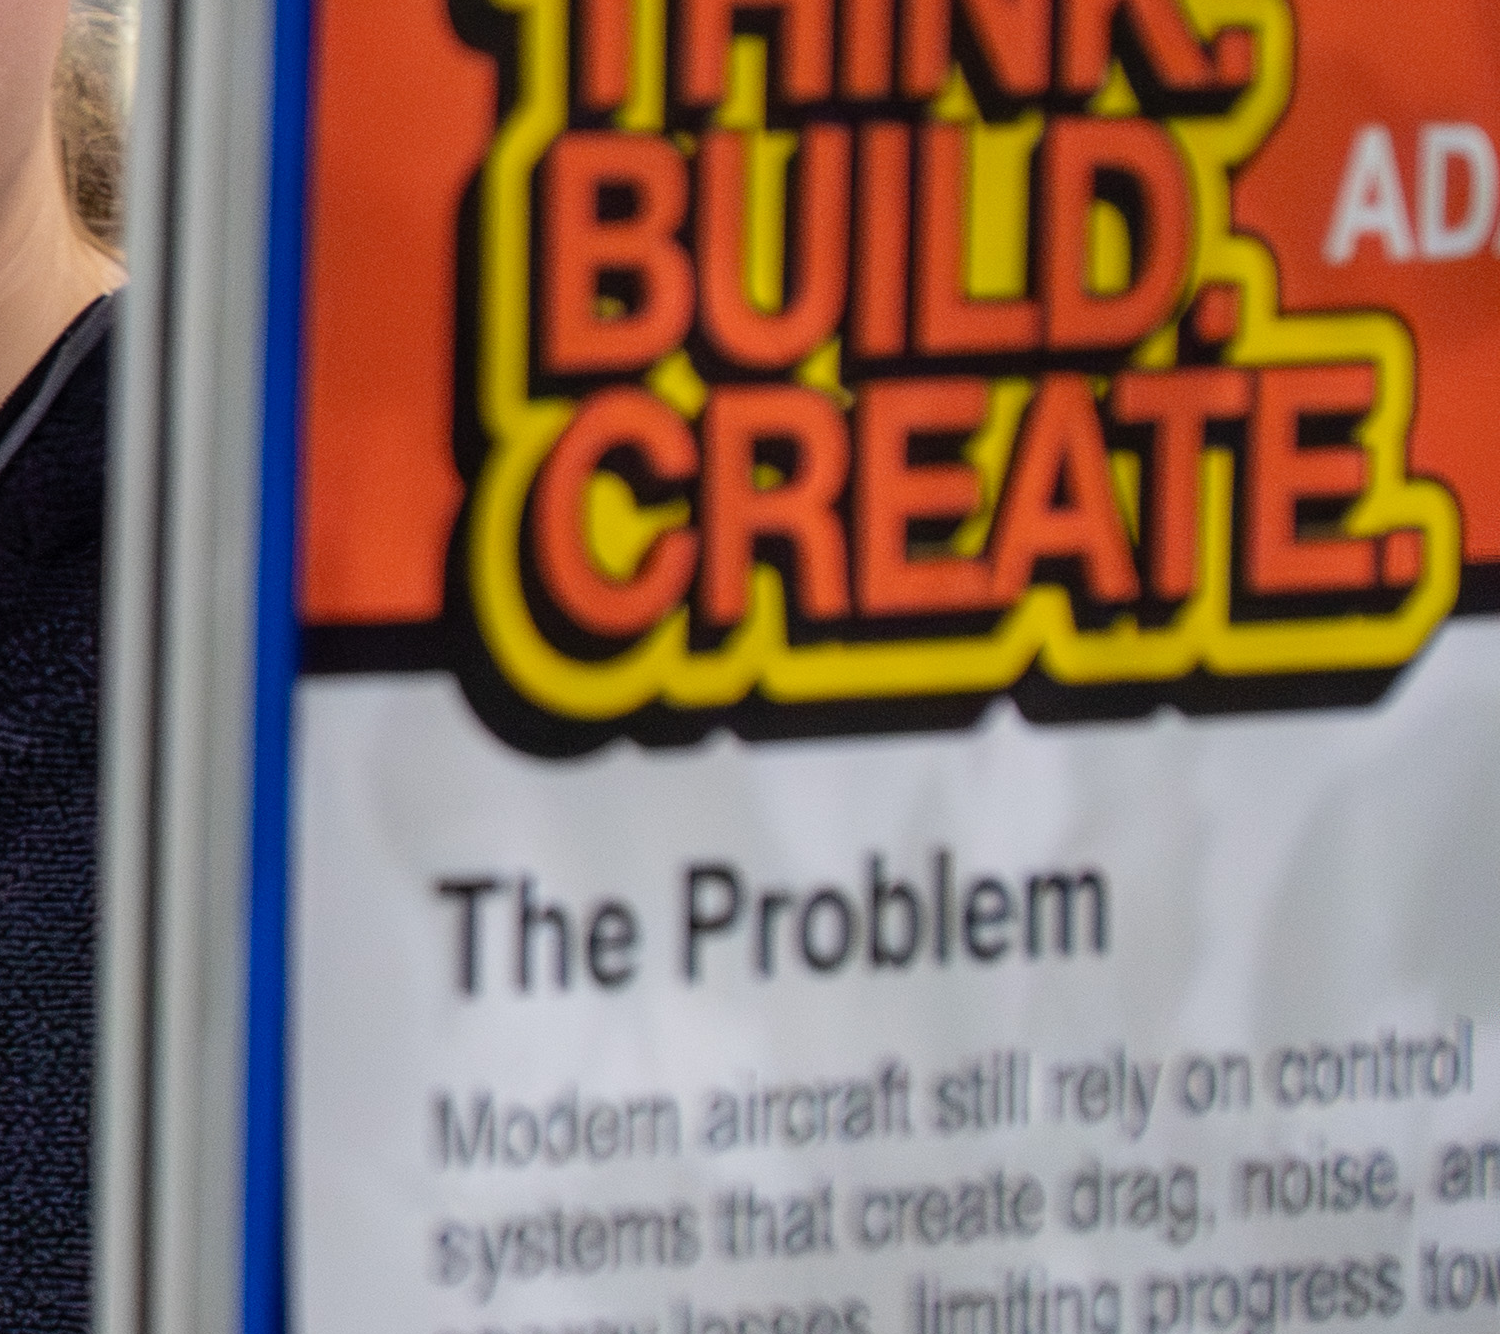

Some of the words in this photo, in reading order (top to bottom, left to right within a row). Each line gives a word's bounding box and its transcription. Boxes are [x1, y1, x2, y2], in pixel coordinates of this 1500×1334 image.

[543, 116, 1240, 375] BUILD.
[1321, 120, 1500, 267] AD
[535, 363, 1424, 635] CREATE.
[436, 875, 640, 997] The
[677, 849, 1110, 983] Problem
[430, 1082, 684, 1169] Modern
[703, 1057, 912, 1151] aircraft
[934, 1049, 1031, 1135] still
[1050, 1042, 1164, 1141] rely
[1180, 1054, 1252, 1116] on
[1272, 1014, 1474, 1108] control
[431, 1200, 700, 1307] systems
[712, 1175, 837, 1262] that
[857, 1167, 1046, 1252] create
[1066, 1155, 1217, 1249] drag,
[1238, 1132, 1414, 1222] noise,
